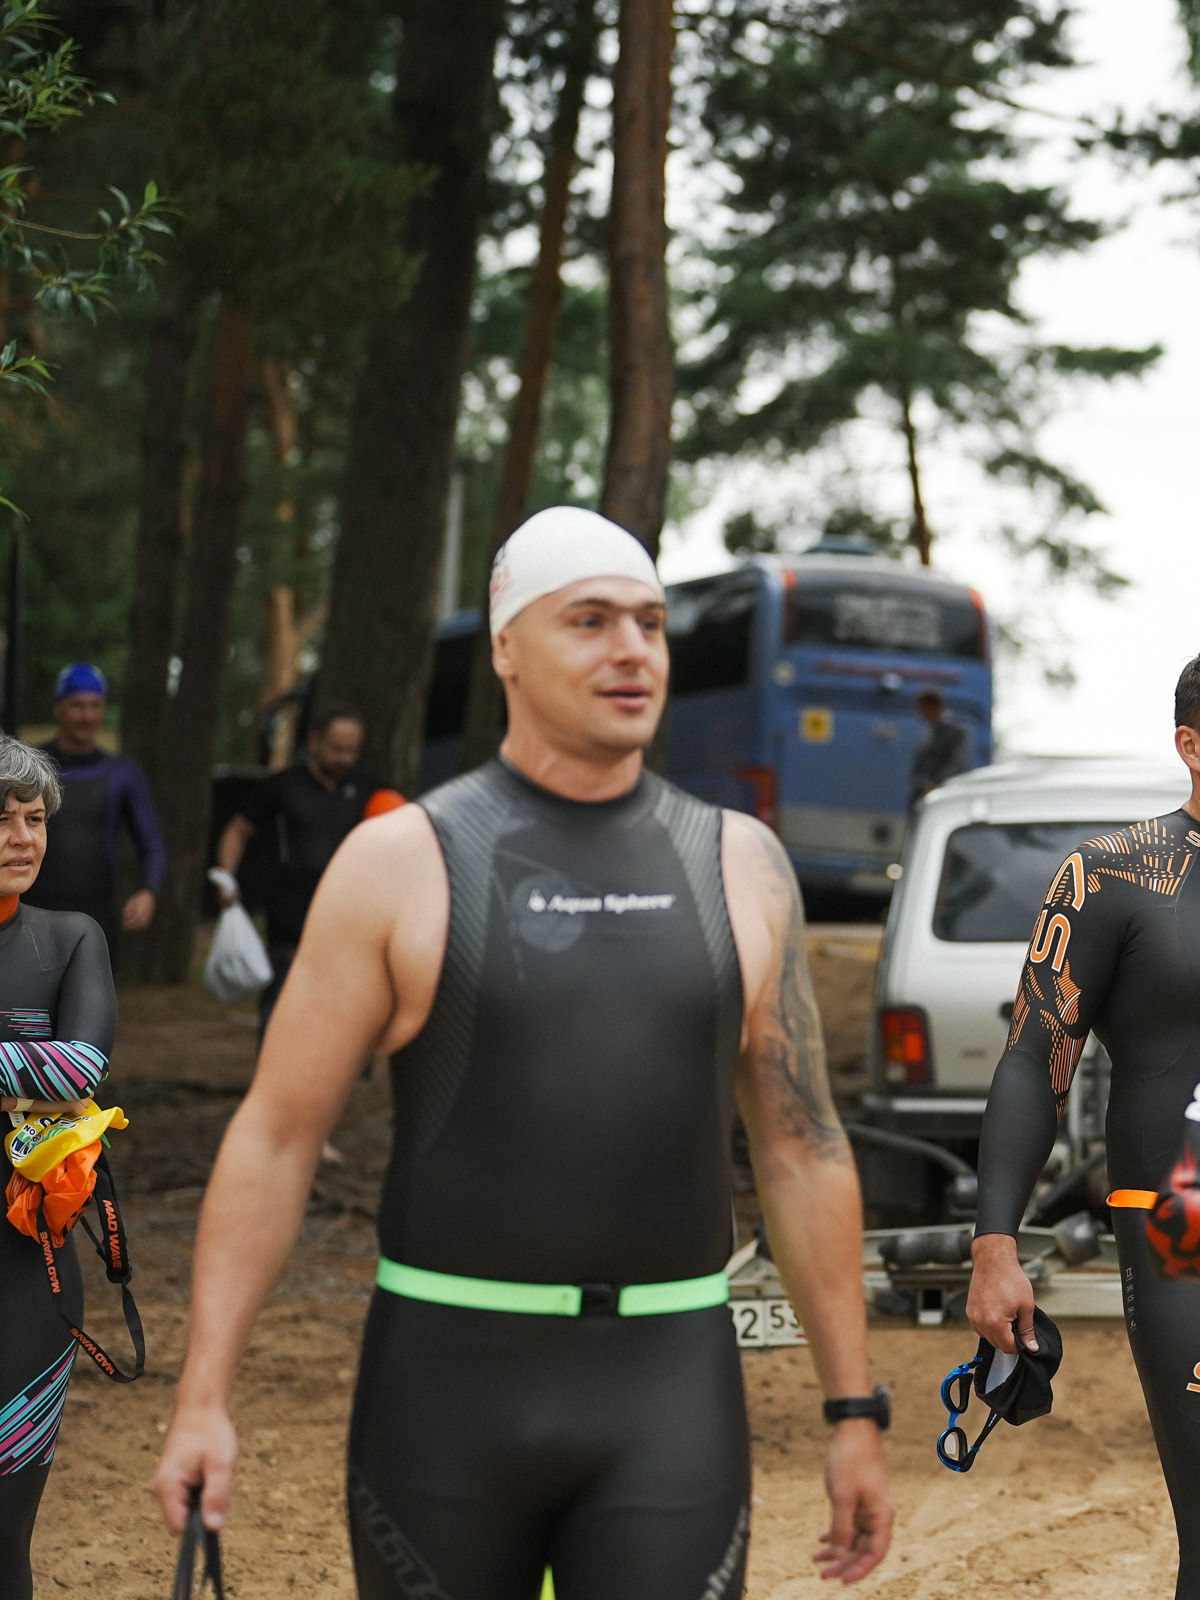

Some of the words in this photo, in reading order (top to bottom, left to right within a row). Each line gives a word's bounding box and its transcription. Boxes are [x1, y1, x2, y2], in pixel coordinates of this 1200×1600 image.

[1029, 852, 1085, 972] S7
[103, 1200, 118, 1231] MAD
[39, 1231, 55, 1267] WAVE
[109, 1233, 122, 1269] WAVE
[48, 1267, 61, 1293] MAD
[69, 1327, 98, 1356] WAVE
[94, 1351, 115, 1375] MAD
